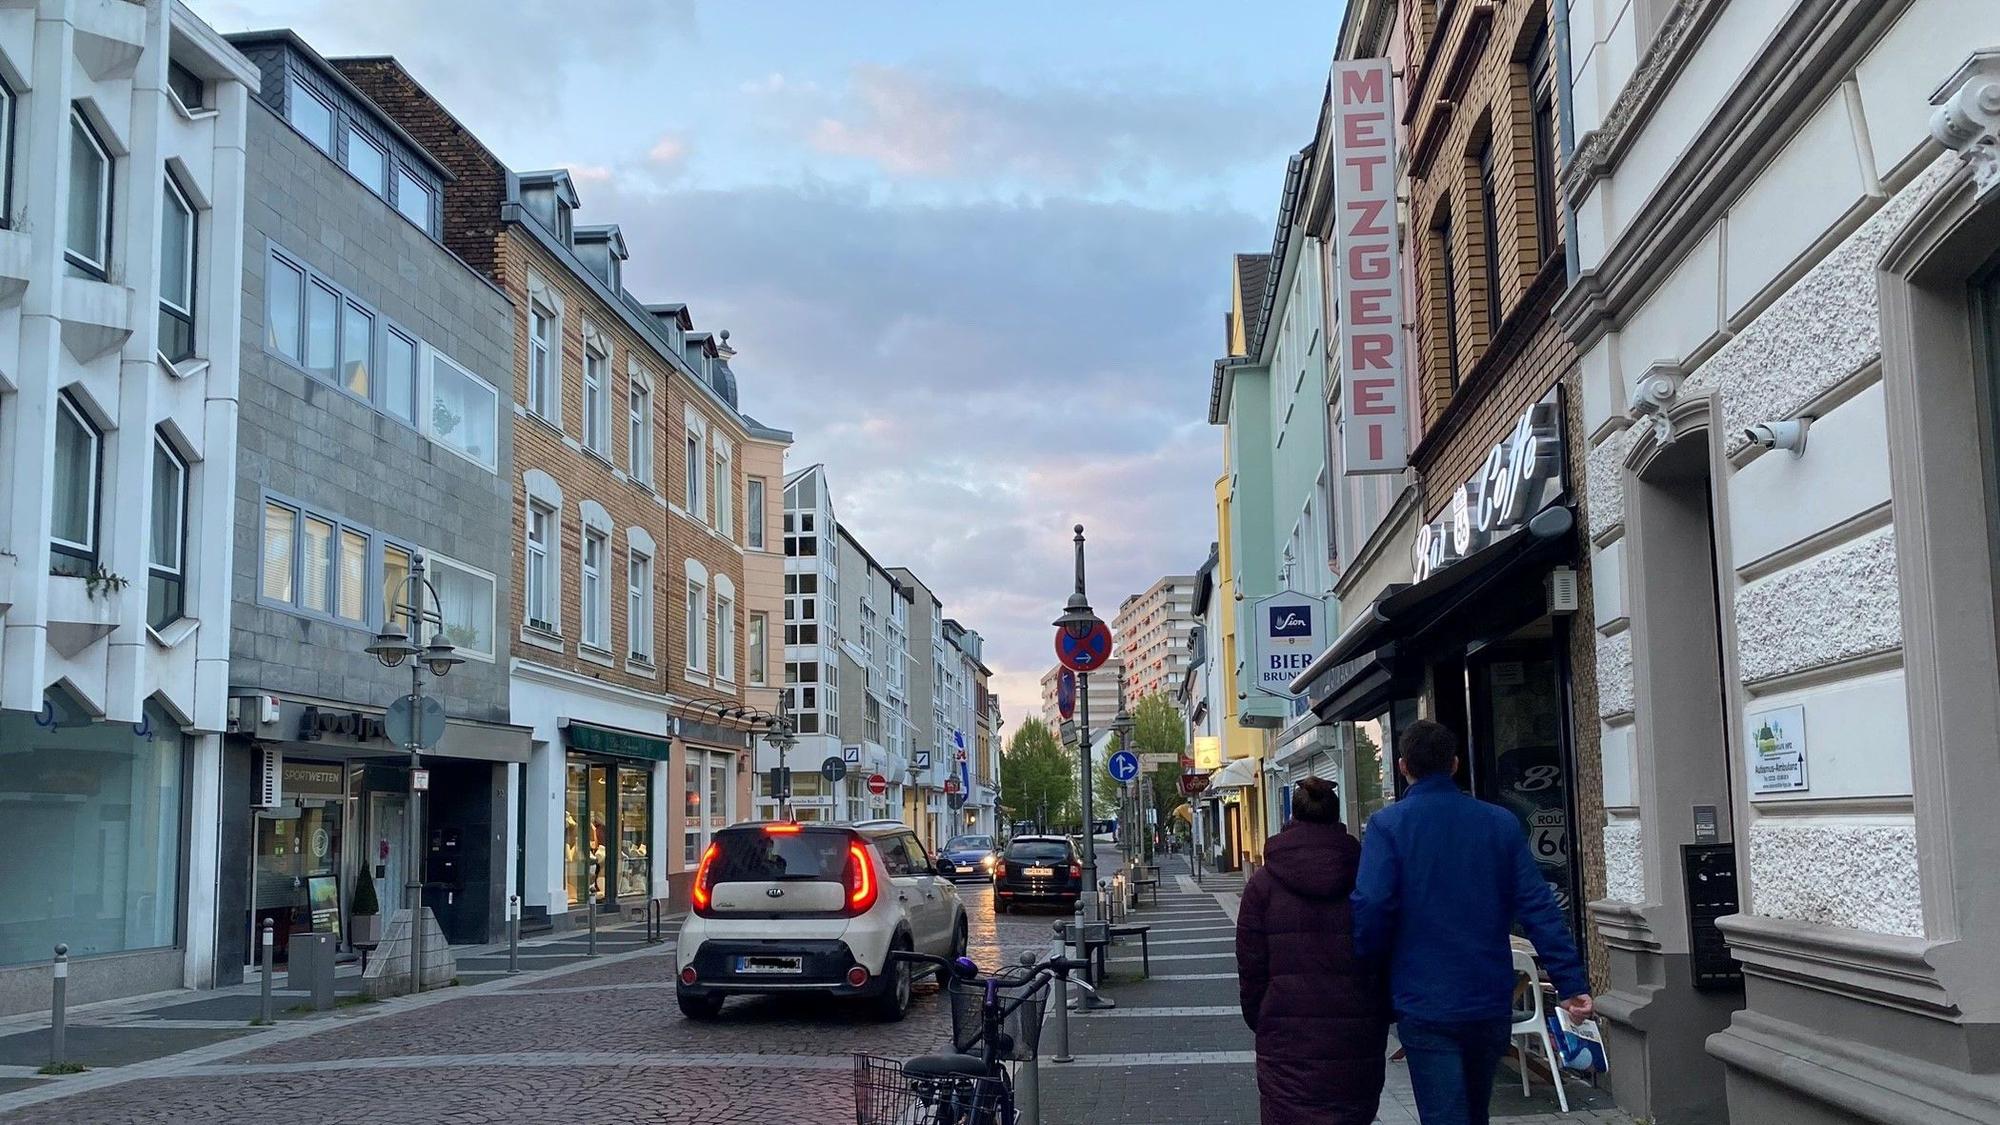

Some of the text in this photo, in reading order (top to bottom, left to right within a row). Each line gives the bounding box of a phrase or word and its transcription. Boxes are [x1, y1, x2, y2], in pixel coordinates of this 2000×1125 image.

[1341, 68, 1396, 461] METZGEREI
[1275, 612, 1307, 630] Sion
[1270, 653, 1313, 669] BIER
[284, 770, 340, 783] SPORTWETTEN
